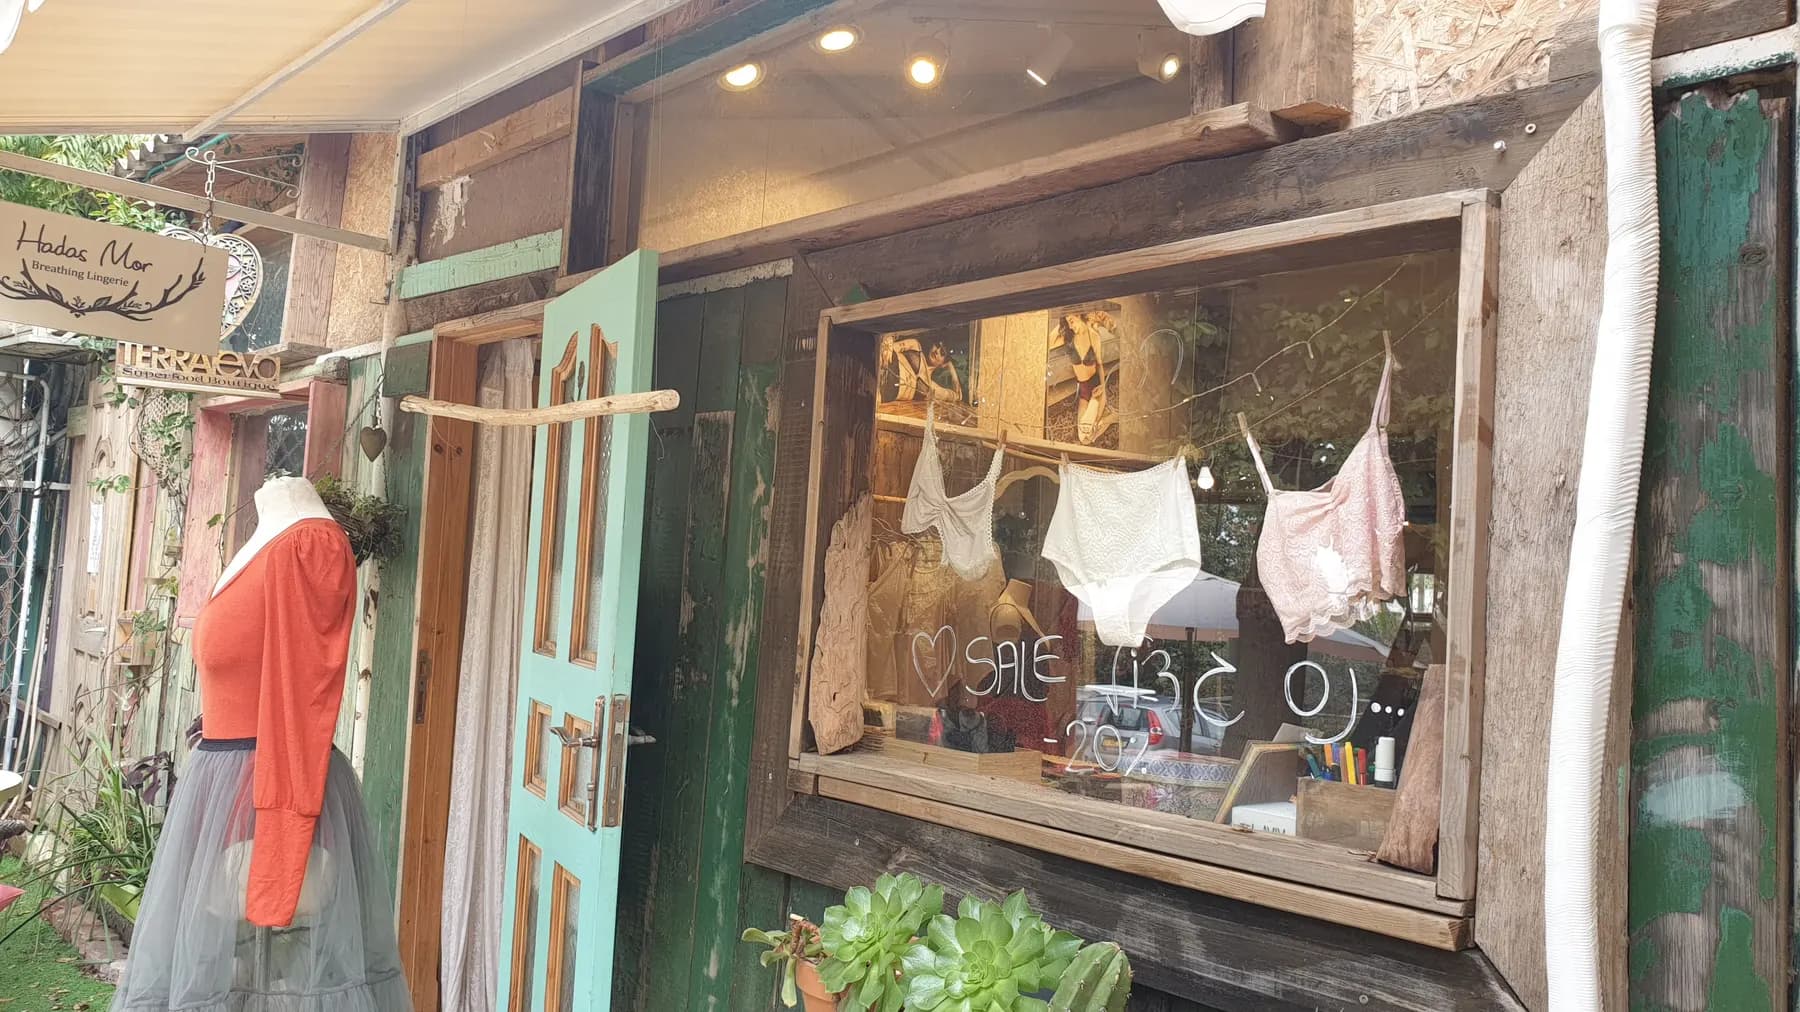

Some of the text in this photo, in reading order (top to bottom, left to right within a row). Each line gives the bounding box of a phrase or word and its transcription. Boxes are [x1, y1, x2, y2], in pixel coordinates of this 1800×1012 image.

[16, 220, 153, 273] Hadas Mor
[31, 259, 130, 288] Breathing Lingerie
[207, 375, 279, 392] Boutique
[965, 634, 1067, 702] SALE
